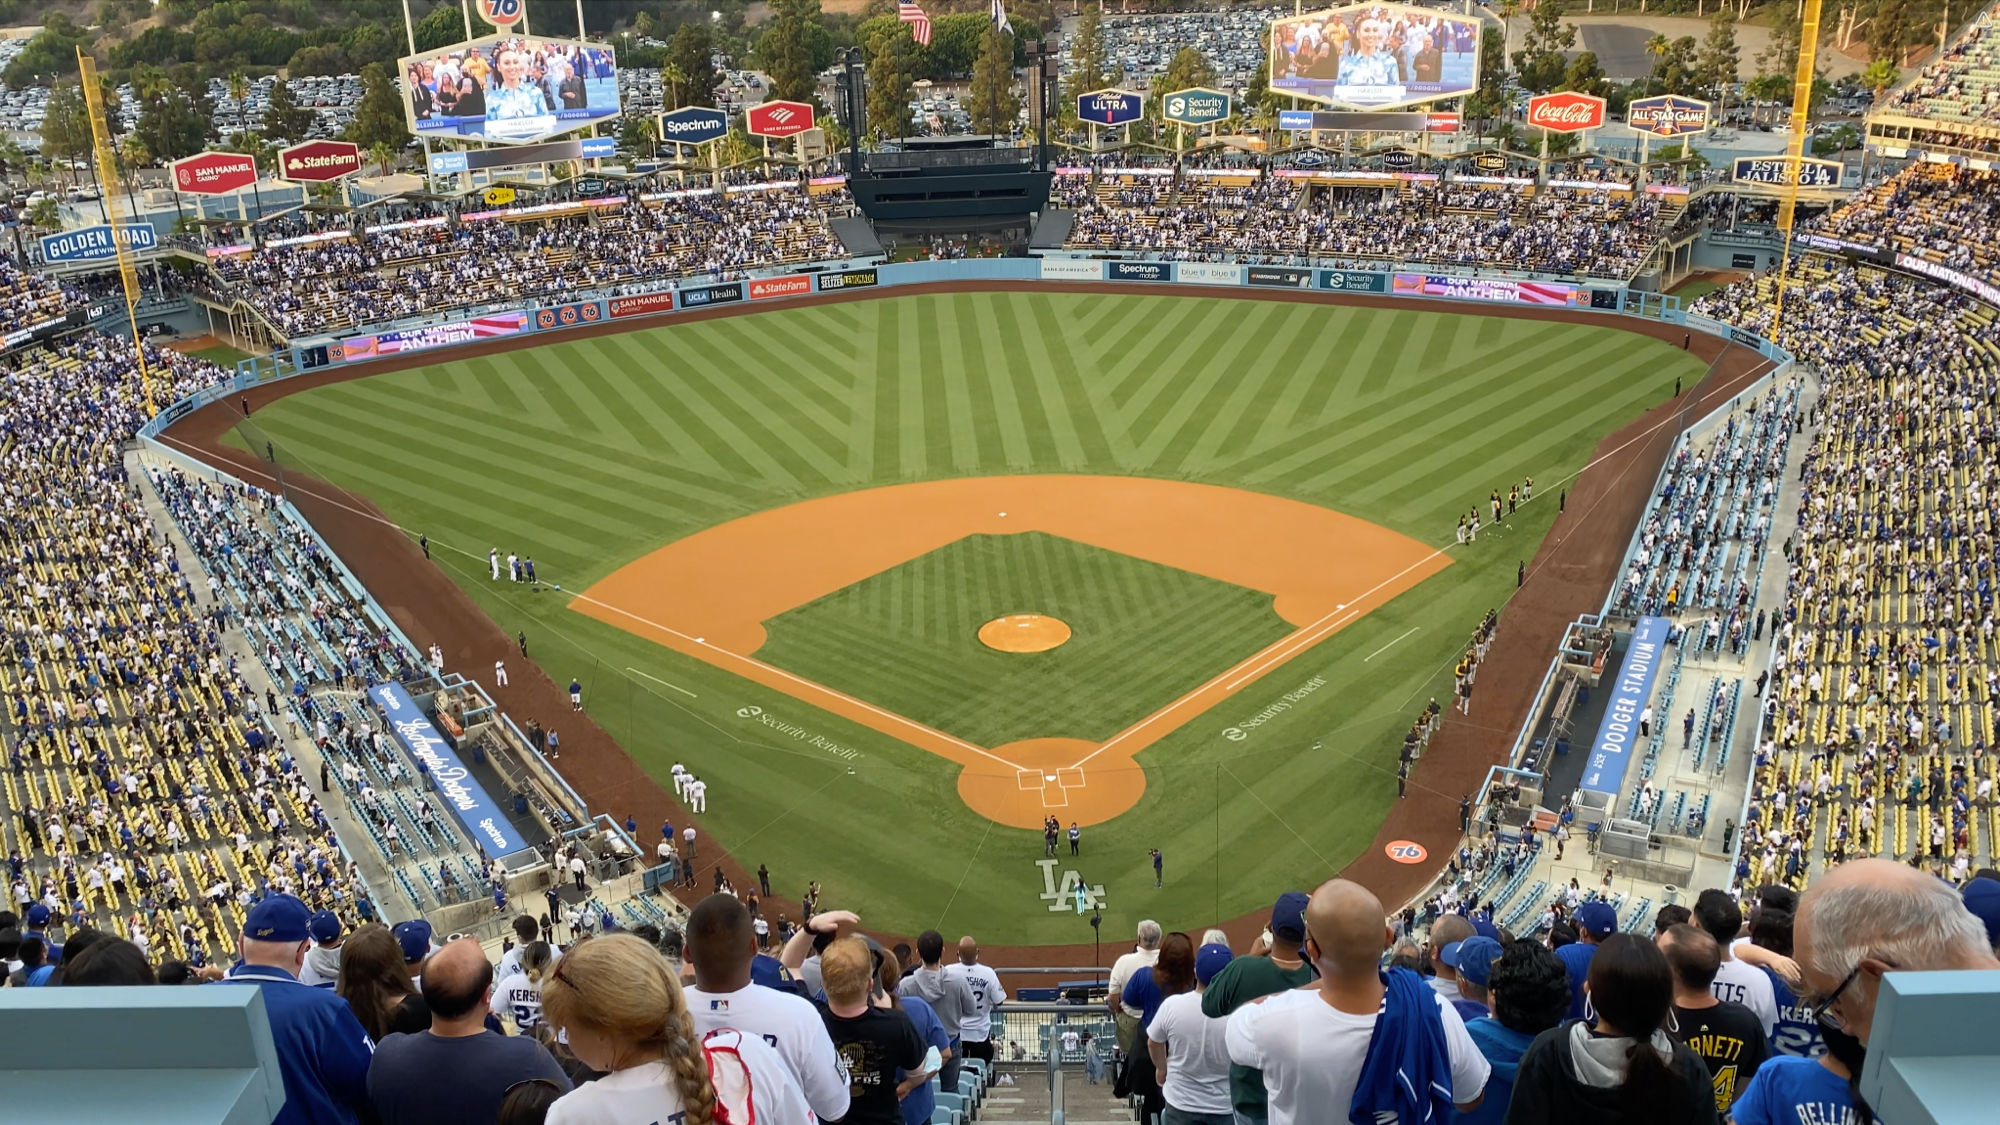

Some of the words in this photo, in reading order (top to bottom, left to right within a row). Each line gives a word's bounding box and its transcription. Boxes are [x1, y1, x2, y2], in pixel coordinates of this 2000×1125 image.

[490, 0, 518, 16] 76
[1092, 100, 1128, 110] ULTRA
[1189, 97, 1224, 110] Security
[1189, 108, 1218, 117] Benefit
[1632, 111, 1649, 120] ALL
[1650, 110, 1674, 120] STAR
[1675, 112, 1704, 122] GAME
[668, 120, 719, 134] Spectrum
[195, 168, 215, 177] SAN
[216, 163, 251, 173] MANUEL
[50, 230, 107, 258] GOLDEN
[1796, 235, 1810, 243] 6:57
[84, 247, 118, 257] BREWIN
[1119, 264, 1157, 273] Spectrum
[1904, 256, 1927, 272] OUR
[1928, 264, 1976, 292] NATIONAL
[821, 278, 844, 288] SELTZER
[1346, 274, 1374, 283] Security
[1447, 278, 1469, 286] OUR
[1471, 279, 1519, 288] NATIONAL
[1346, 281, 1370, 290] Benefit
[688, 293, 706, 302] UCLA
[711, 289, 737, 300] Health
[1444, 285, 1519, 300] ANTHEM
[1579, 293, 1589, 301] 76
[620, 299, 637, 308] SAN
[639, 296, 670, 306] MANUEL
[90, 306, 103, 317] 6:57
[563, 311, 574, 320] 76
[584, 307, 596, 316] 76
[542, 314, 552, 322] 76
[399, 326, 421, 338] OUR
[424, 321, 473, 334] NATIONAL
[400, 330, 475, 352] ANTHEM
[331, 348, 341, 357] 76
[379, 687, 400, 710] Spectrum
[1602, 699, 1637, 753] DODGER
[1622, 643, 1656, 694] STADIUM
[1239, 700, 1292, 730] Security
[1283, 679, 1326, 702] Benefit
[756, 714, 810, 741] Security
[808, 735, 858, 760] Benefit
[409, 737, 449, 776] Angeles
[436, 767, 479, 811] Dodgers
[480, 817, 507, 849] Spectrum
[1392, 846, 1422, 858] 76
[1035, 858, 1106, 912] LA
[1712, 1065, 1738, 1112] 4
